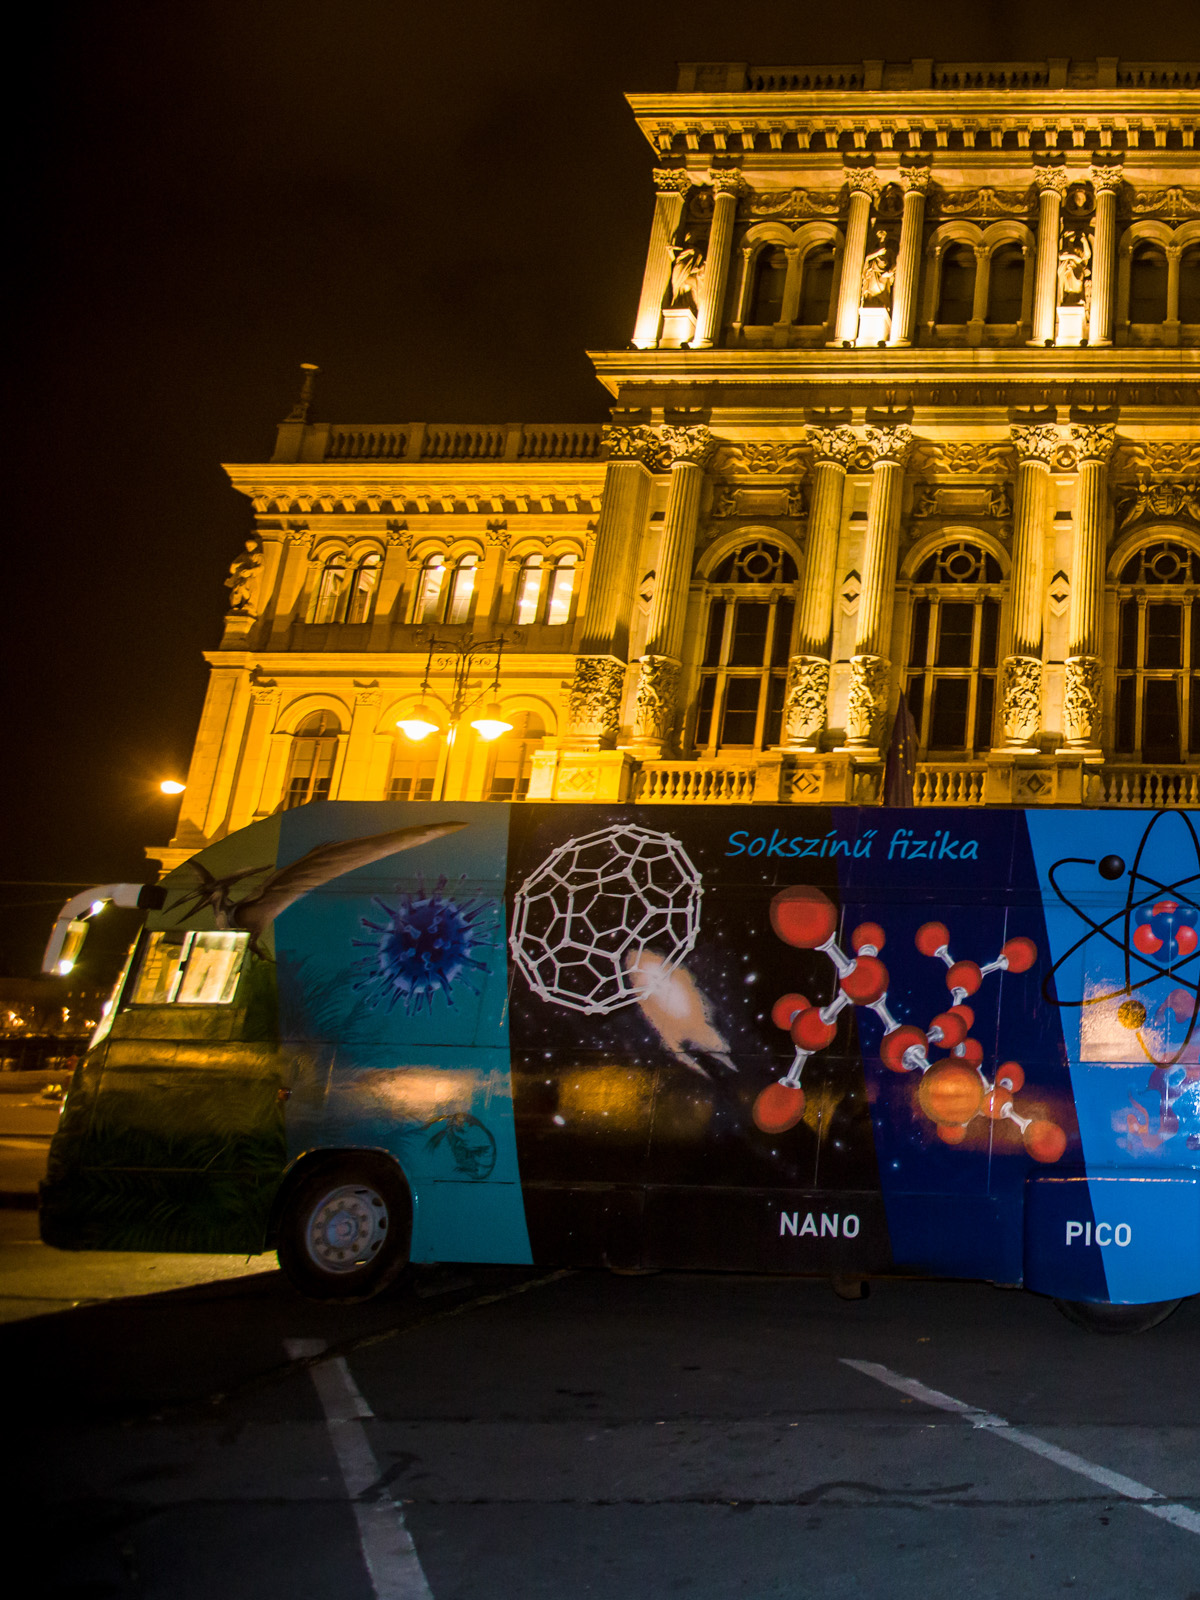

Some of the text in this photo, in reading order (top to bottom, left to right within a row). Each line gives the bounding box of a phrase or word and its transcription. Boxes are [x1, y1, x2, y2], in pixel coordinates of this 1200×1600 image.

[725, 828, 979, 860] Sokszínű fizika
[779, 1211, 861, 1239] NANO
[1064, 1221, 1133, 1247] PICO
